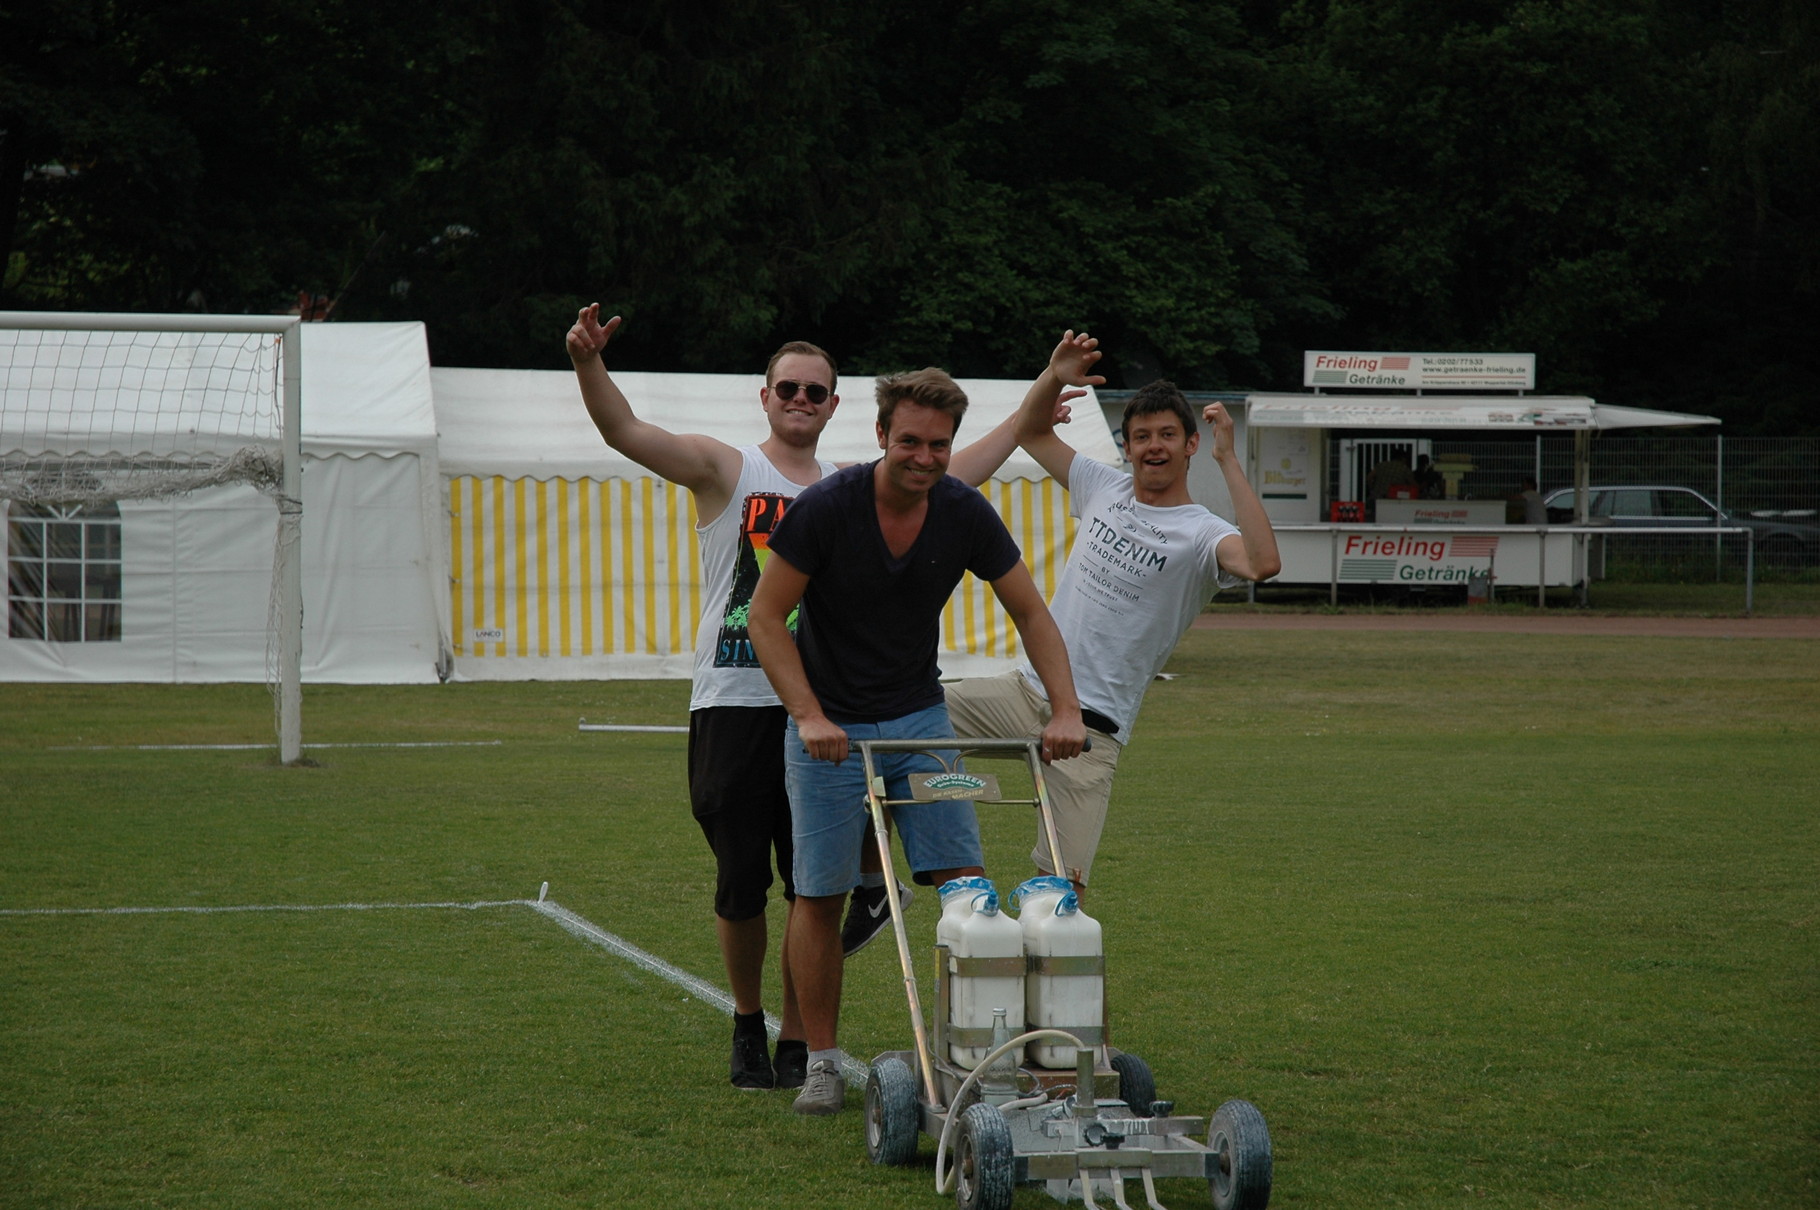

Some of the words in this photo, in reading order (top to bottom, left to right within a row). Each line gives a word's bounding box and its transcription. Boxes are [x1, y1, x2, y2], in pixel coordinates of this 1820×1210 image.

[1316, 355, 1378, 372] Frieling
[1422, 366, 1527, 374] www.getraenke-frieling.de
[1349, 374, 1406, 385] Getränke
[746, 498, 786, 532] PA
[1088, 516, 1168, 572] TTDENIM
[1344, 535, 1446, 561] Frieling
[1101, 566, 1110, 575] BY
[1399, 565, 1490, 581] Getränke
[1088, 570, 1112, 590] TAILOR
[1113, 585, 1141, 602] DENIM
[720, 639, 755, 661] SIN
[923, 773, 987, 788] EUROGREEN
[951, 789, 985, 800] MACHER
